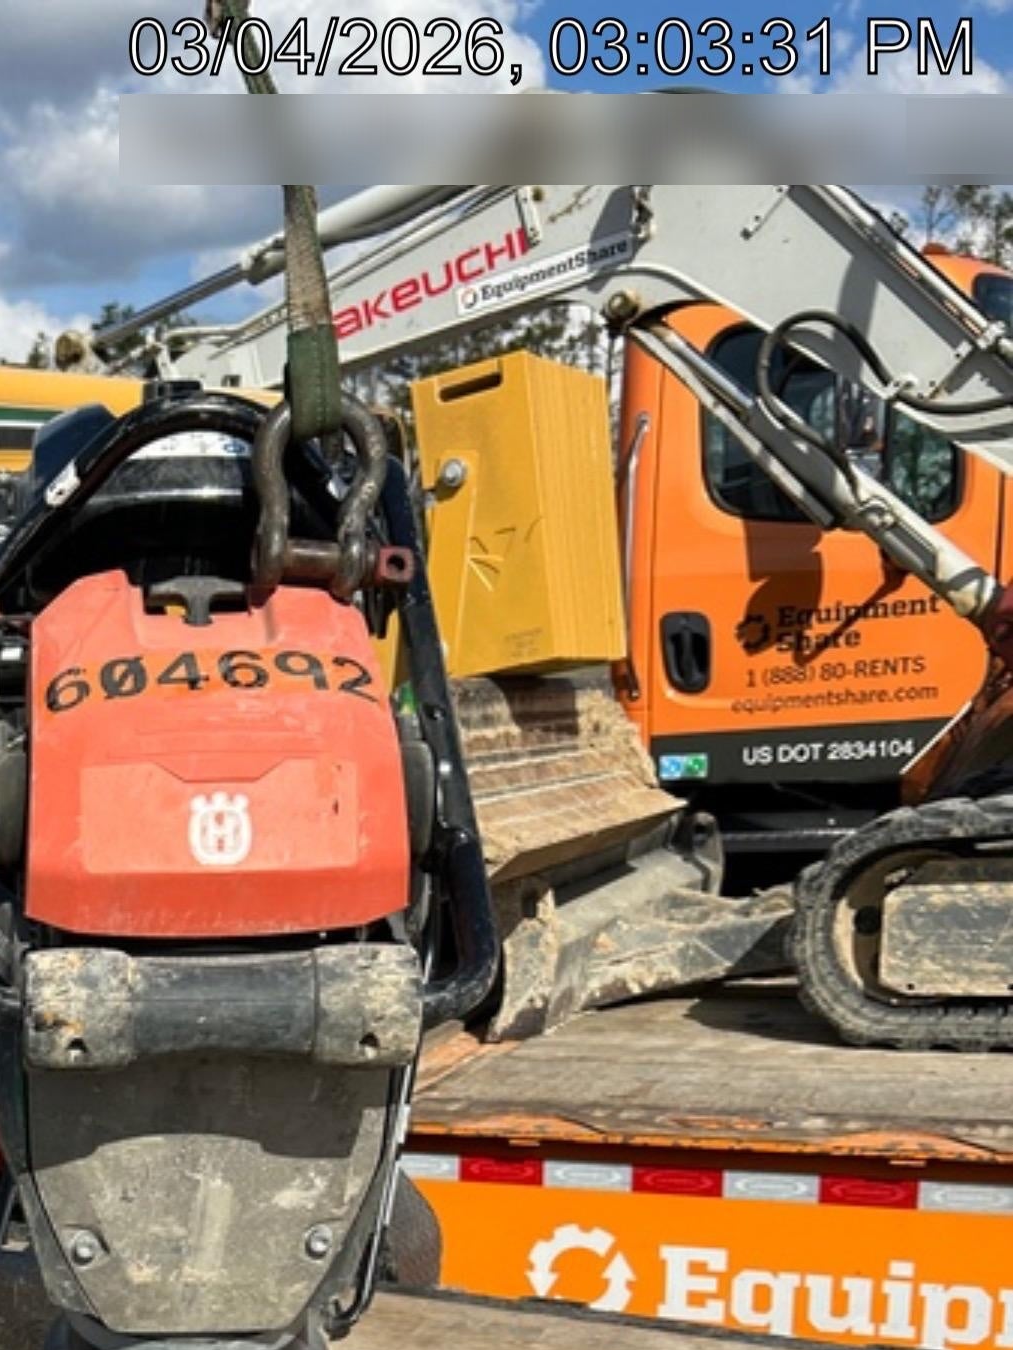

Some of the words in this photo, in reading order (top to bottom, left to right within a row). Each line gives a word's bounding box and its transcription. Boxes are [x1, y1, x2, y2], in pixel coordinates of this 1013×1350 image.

[480, 238, 629, 303] EquipmentShare
[776, 592, 942, 632] Equipment
[776, 627, 861, 653] Share
[45, 650, 380, 713] 604692
[746, 667, 757, 689] 1
[761, 664, 817, 688] (888)
[820, 655, 926, 682] 80-RENTS
[730, 686, 940, 714] equipmentshare.com
[742, 743, 774, 766] US
[776, 742, 824, 764] DOT
[826, 738, 916, 762] 2834104
